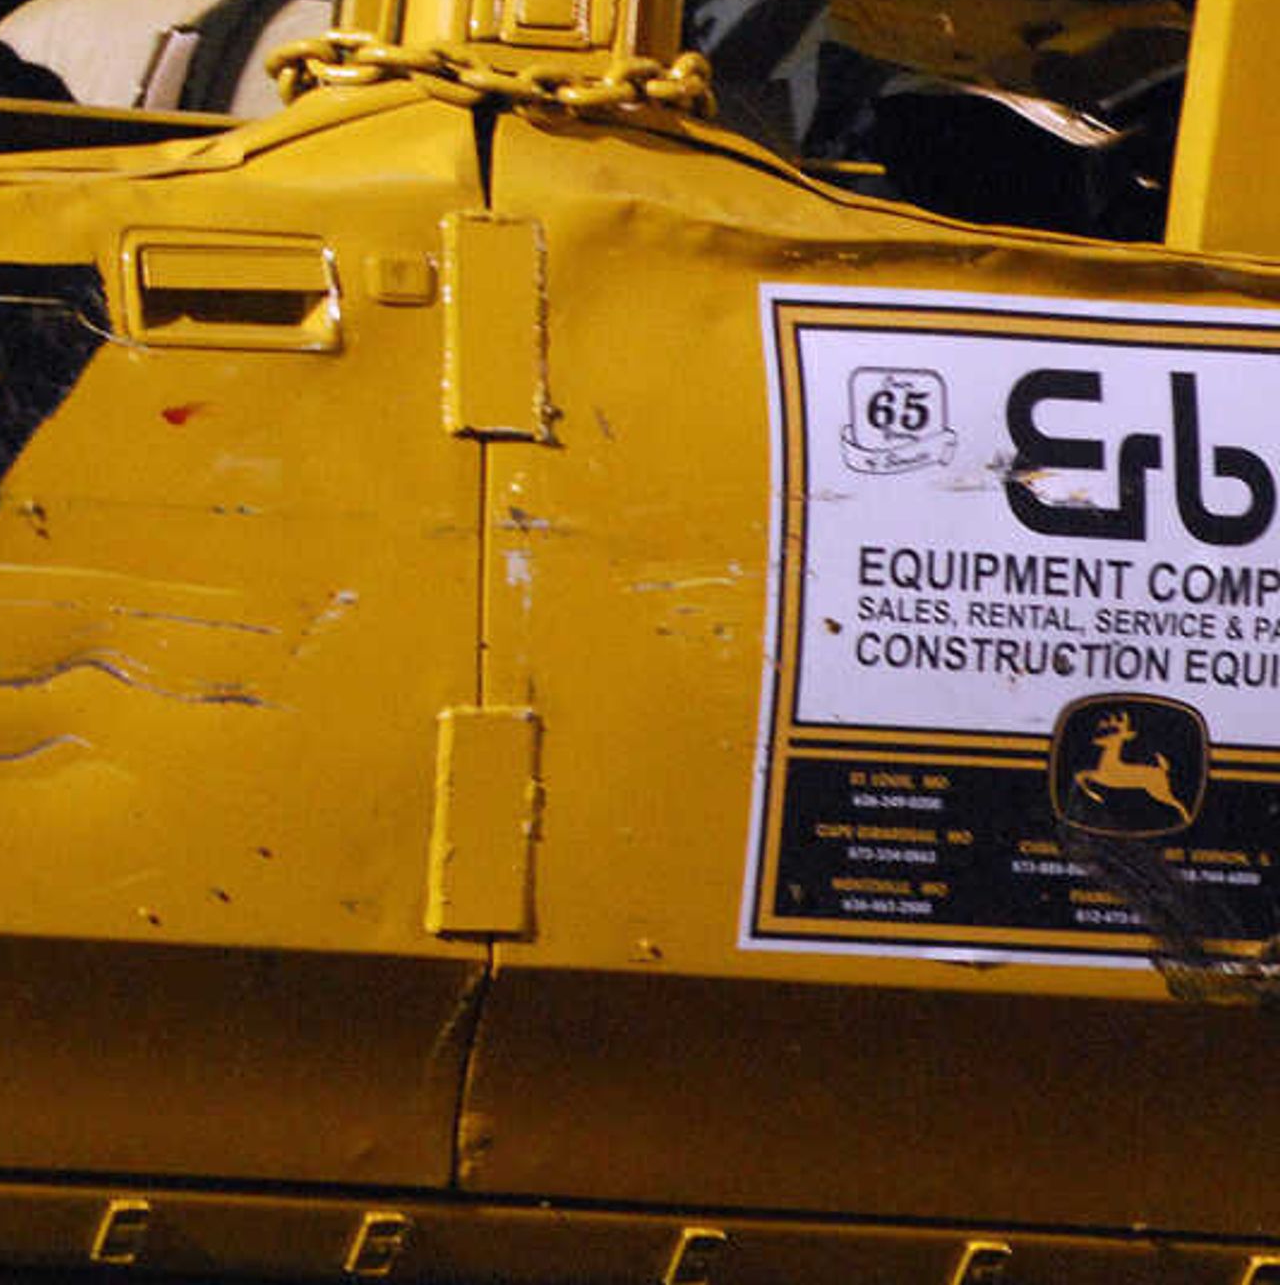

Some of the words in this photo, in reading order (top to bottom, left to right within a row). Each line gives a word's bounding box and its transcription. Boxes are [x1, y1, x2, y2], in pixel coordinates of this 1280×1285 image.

[866, 389, 930, 432] 65
[1005, 368, 1278, 547] Erb
[858, 546, 1134, 600] EQUIPMENT
[1147, 562, 1280, 608] COMP
[857, 596, 958, 628] SALES,
[967, 601, 1087, 635] RENTAL,
[1094, 608, 1216, 640] SERVICE
[1224, 616, 1244, 641] &
[856, 631, 1171, 682] CONSTRUCTION
